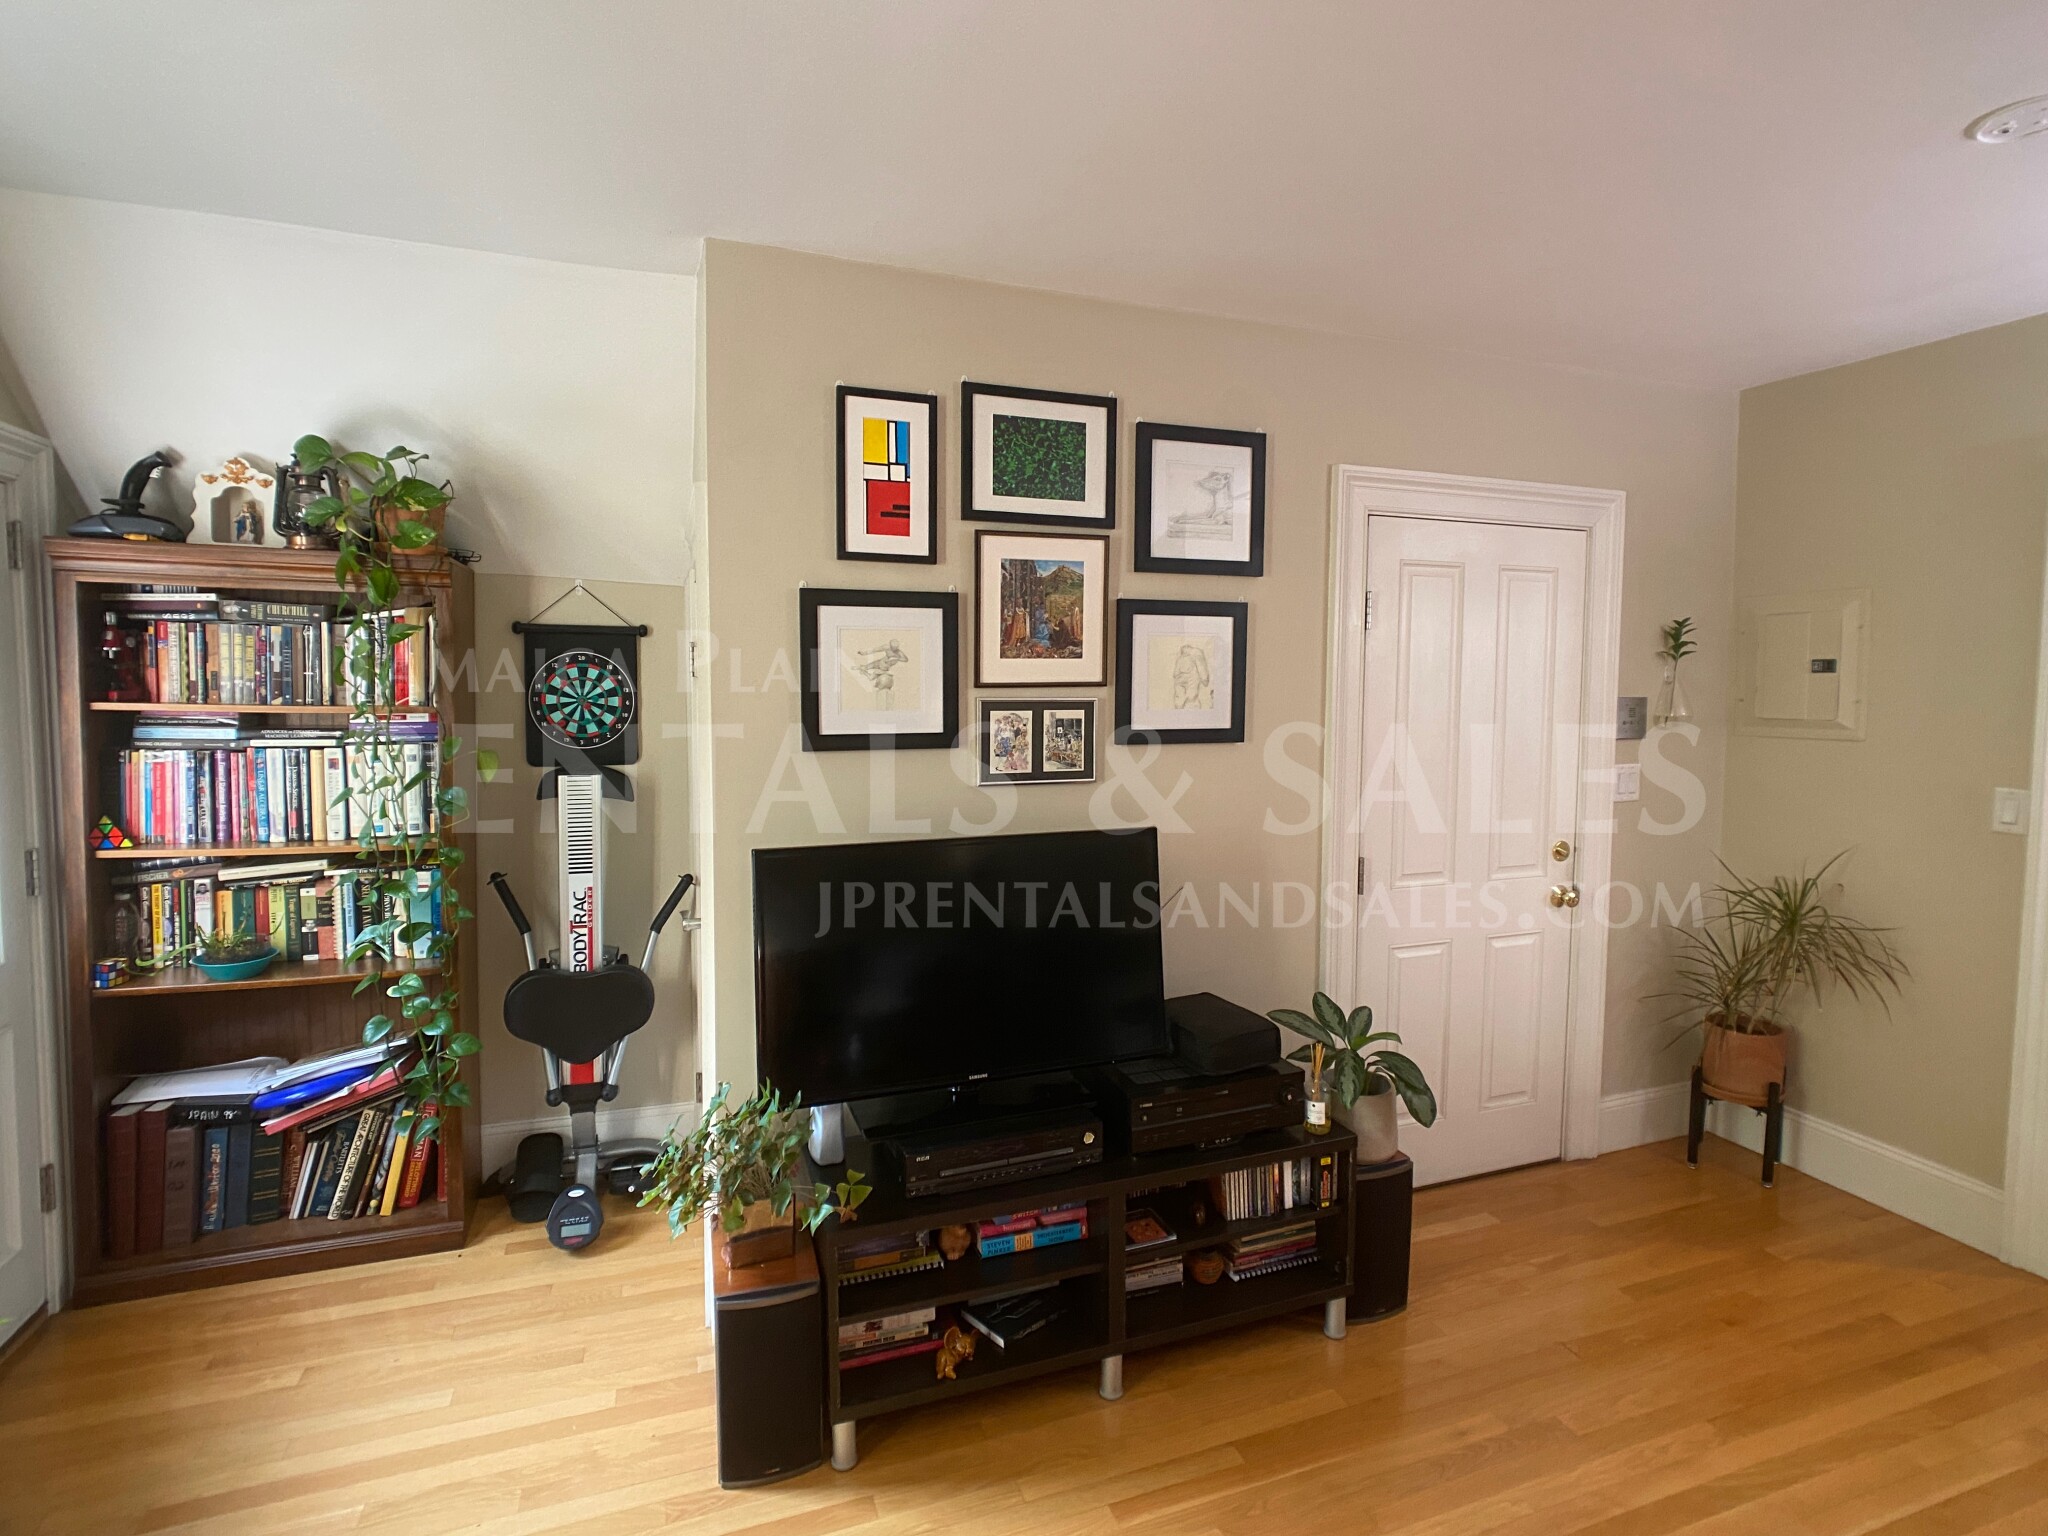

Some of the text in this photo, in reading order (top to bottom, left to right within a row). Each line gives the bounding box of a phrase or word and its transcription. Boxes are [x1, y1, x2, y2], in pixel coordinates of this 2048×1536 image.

[265, 604, 309, 617] CHURCHILL
[258, 793, 266, 819] ALGEBRA
[138, 871, 169, 881] FISCHER
[361, 885, 372, 913] SECUTY
[569, 891, 588, 973] BODYTRAC
[968, 1072, 988, 1080] SAMSUNG
[188, 1109, 219, 1121] SPAIN
[359, 1112, 371, 1132] GREAT
[413, 1113, 430, 1158] CMAN
[344, 1132, 364, 1174] ARCHITECTURE
[290, 1155, 301, 1188] WILLIAM
[342, 1174, 351, 1185] OF
[410, 1161, 422, 1192] PILOTING
[339, 1184, 348, 1195] THE
[331, 1194, 346, 1219] WORLD
[986, 1239, 1011, 1248] STEVEN
